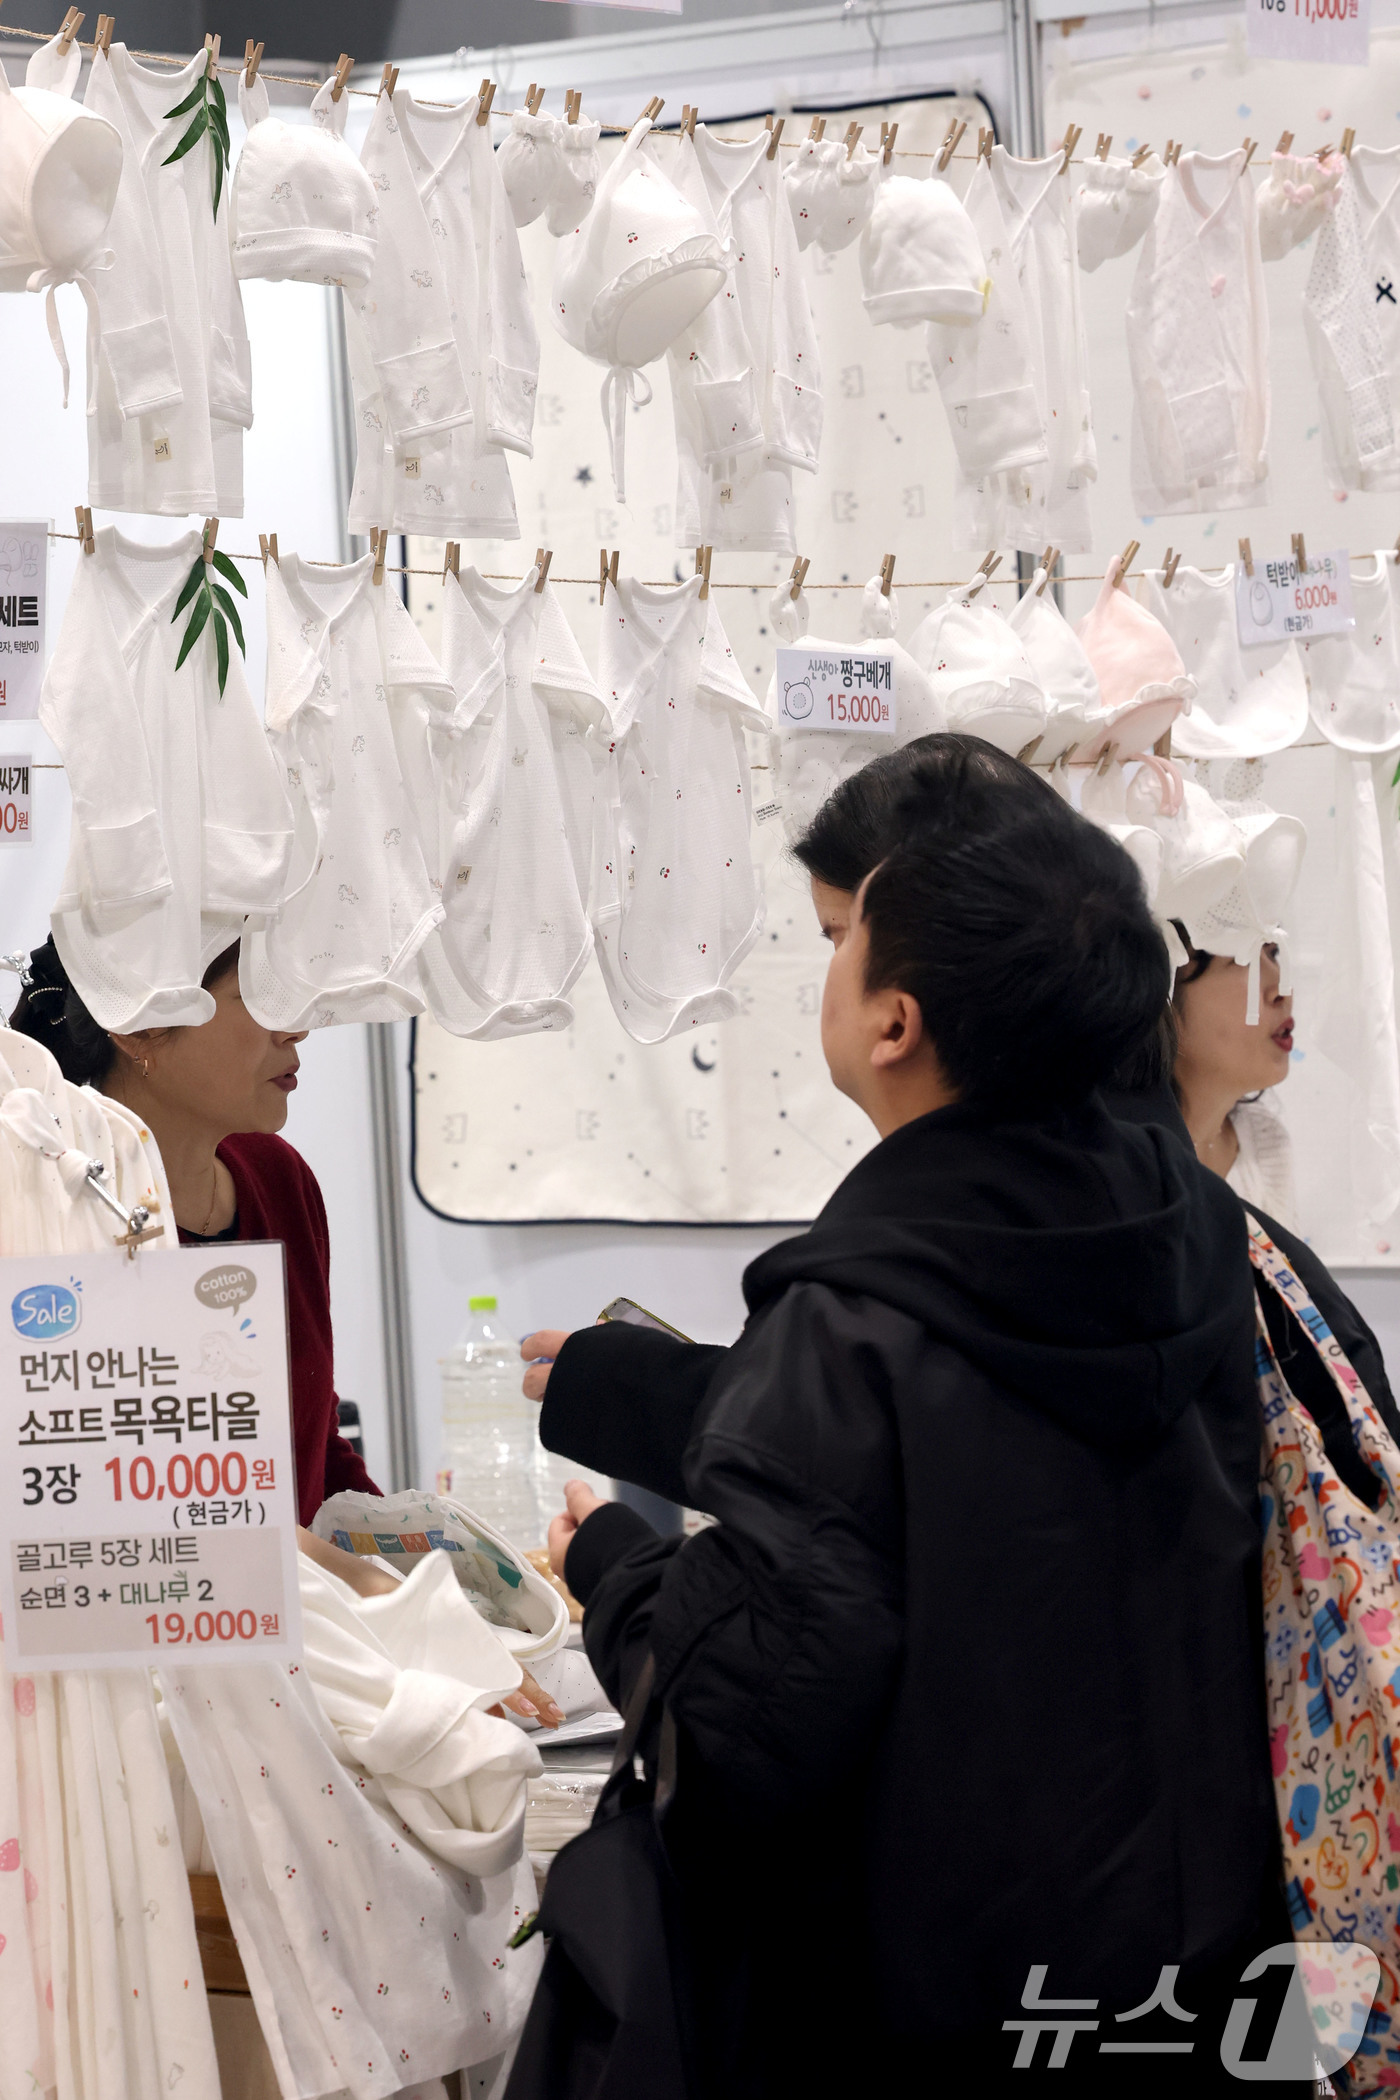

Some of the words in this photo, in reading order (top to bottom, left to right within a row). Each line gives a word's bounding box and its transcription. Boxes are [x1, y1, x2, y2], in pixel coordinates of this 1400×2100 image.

[840, 659, 891, 691] 짱구베개
[827, 693, 889, 723] 15,000원
[200, 1269, 248, 1292] cotton
[214, 1286, 248, 1304] 100%
[17, 1294, 73, 1327] Sale
[20, 1349, 80, 1392] 먼지
[86, 1346, 179, 1389] 안나는
[22, 1463, 81, 1506] 3장
[16, 1541, 94, 1572] 골고루
[100, 1538, 143, 1567] 5장
[149, 1536, 200, 1565] 세트
[20, 1583, 68, 1610] 순면
[74, 1585, 91, 1608] 3
[119, 1581, 190, 1606] 대나무
[197, 1579, 214, 1602] 2
